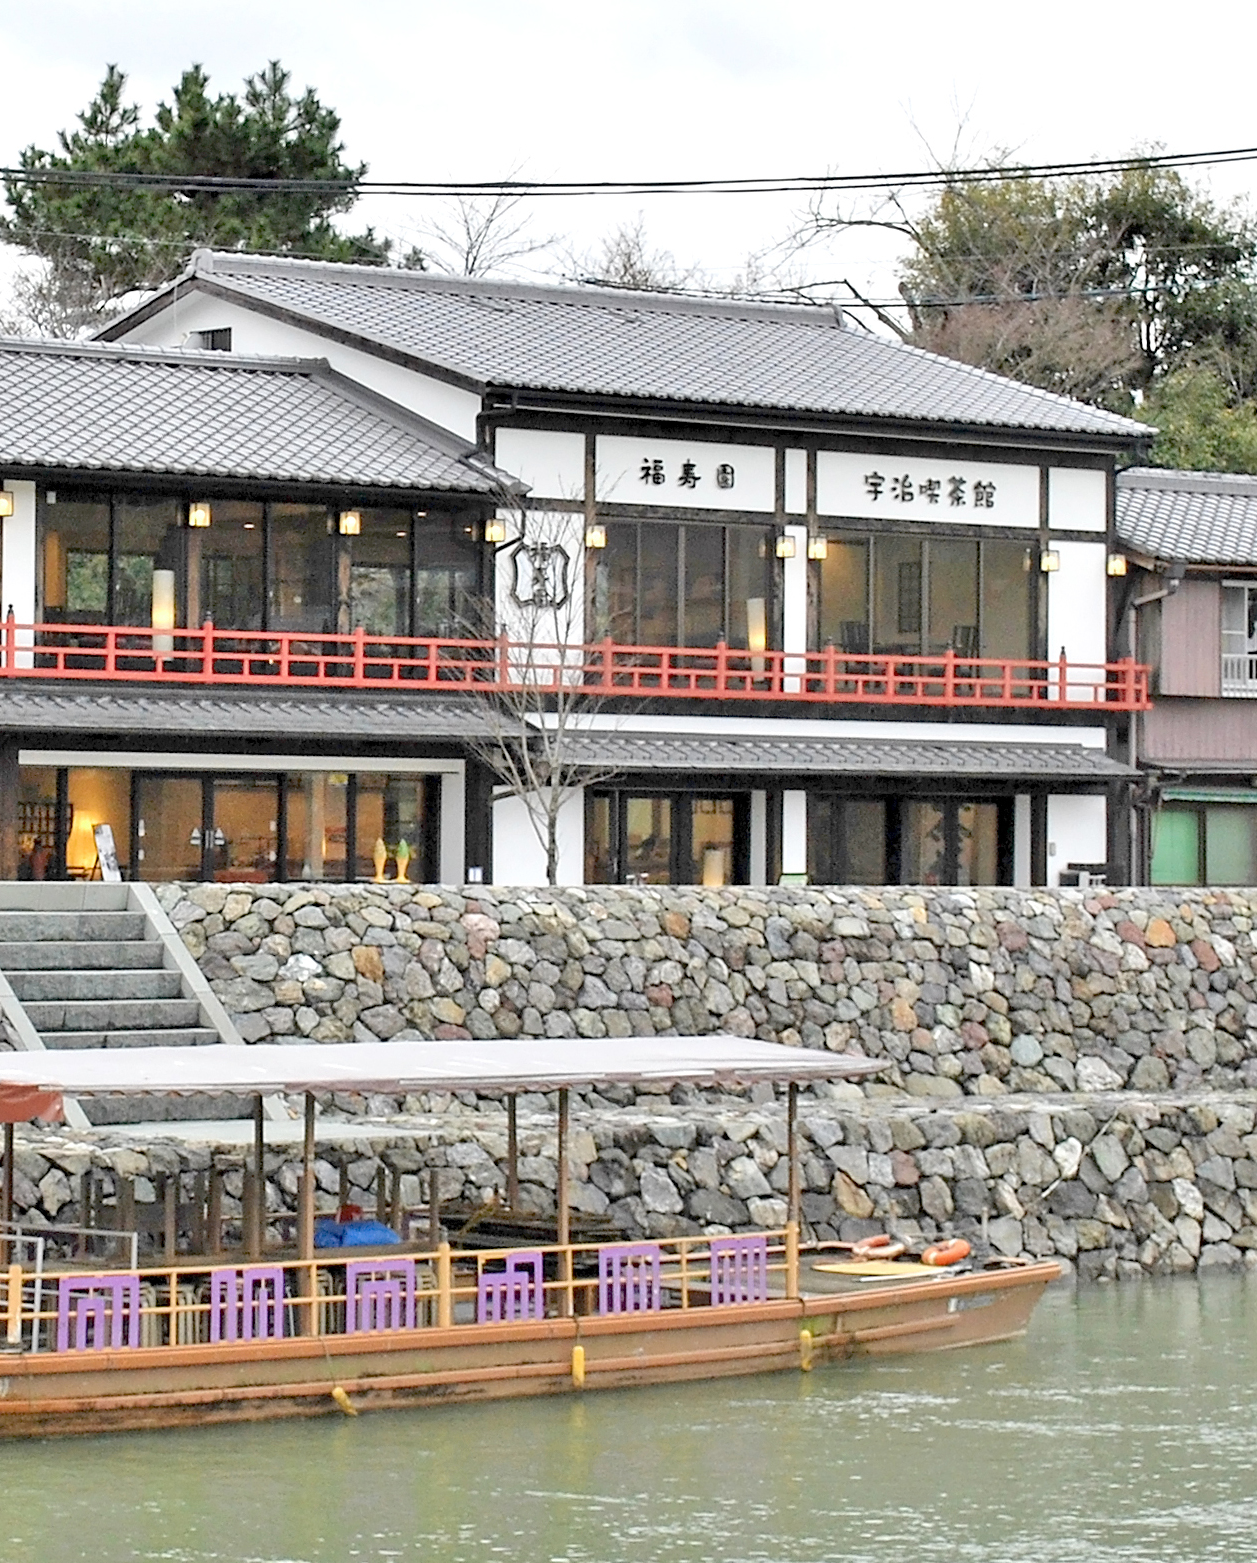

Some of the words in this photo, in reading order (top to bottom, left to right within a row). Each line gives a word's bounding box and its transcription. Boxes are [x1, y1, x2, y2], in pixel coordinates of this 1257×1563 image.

[639, 457, 735, 489] 福寿園
[863, 471, 997, 508] 宇治喫茶館
